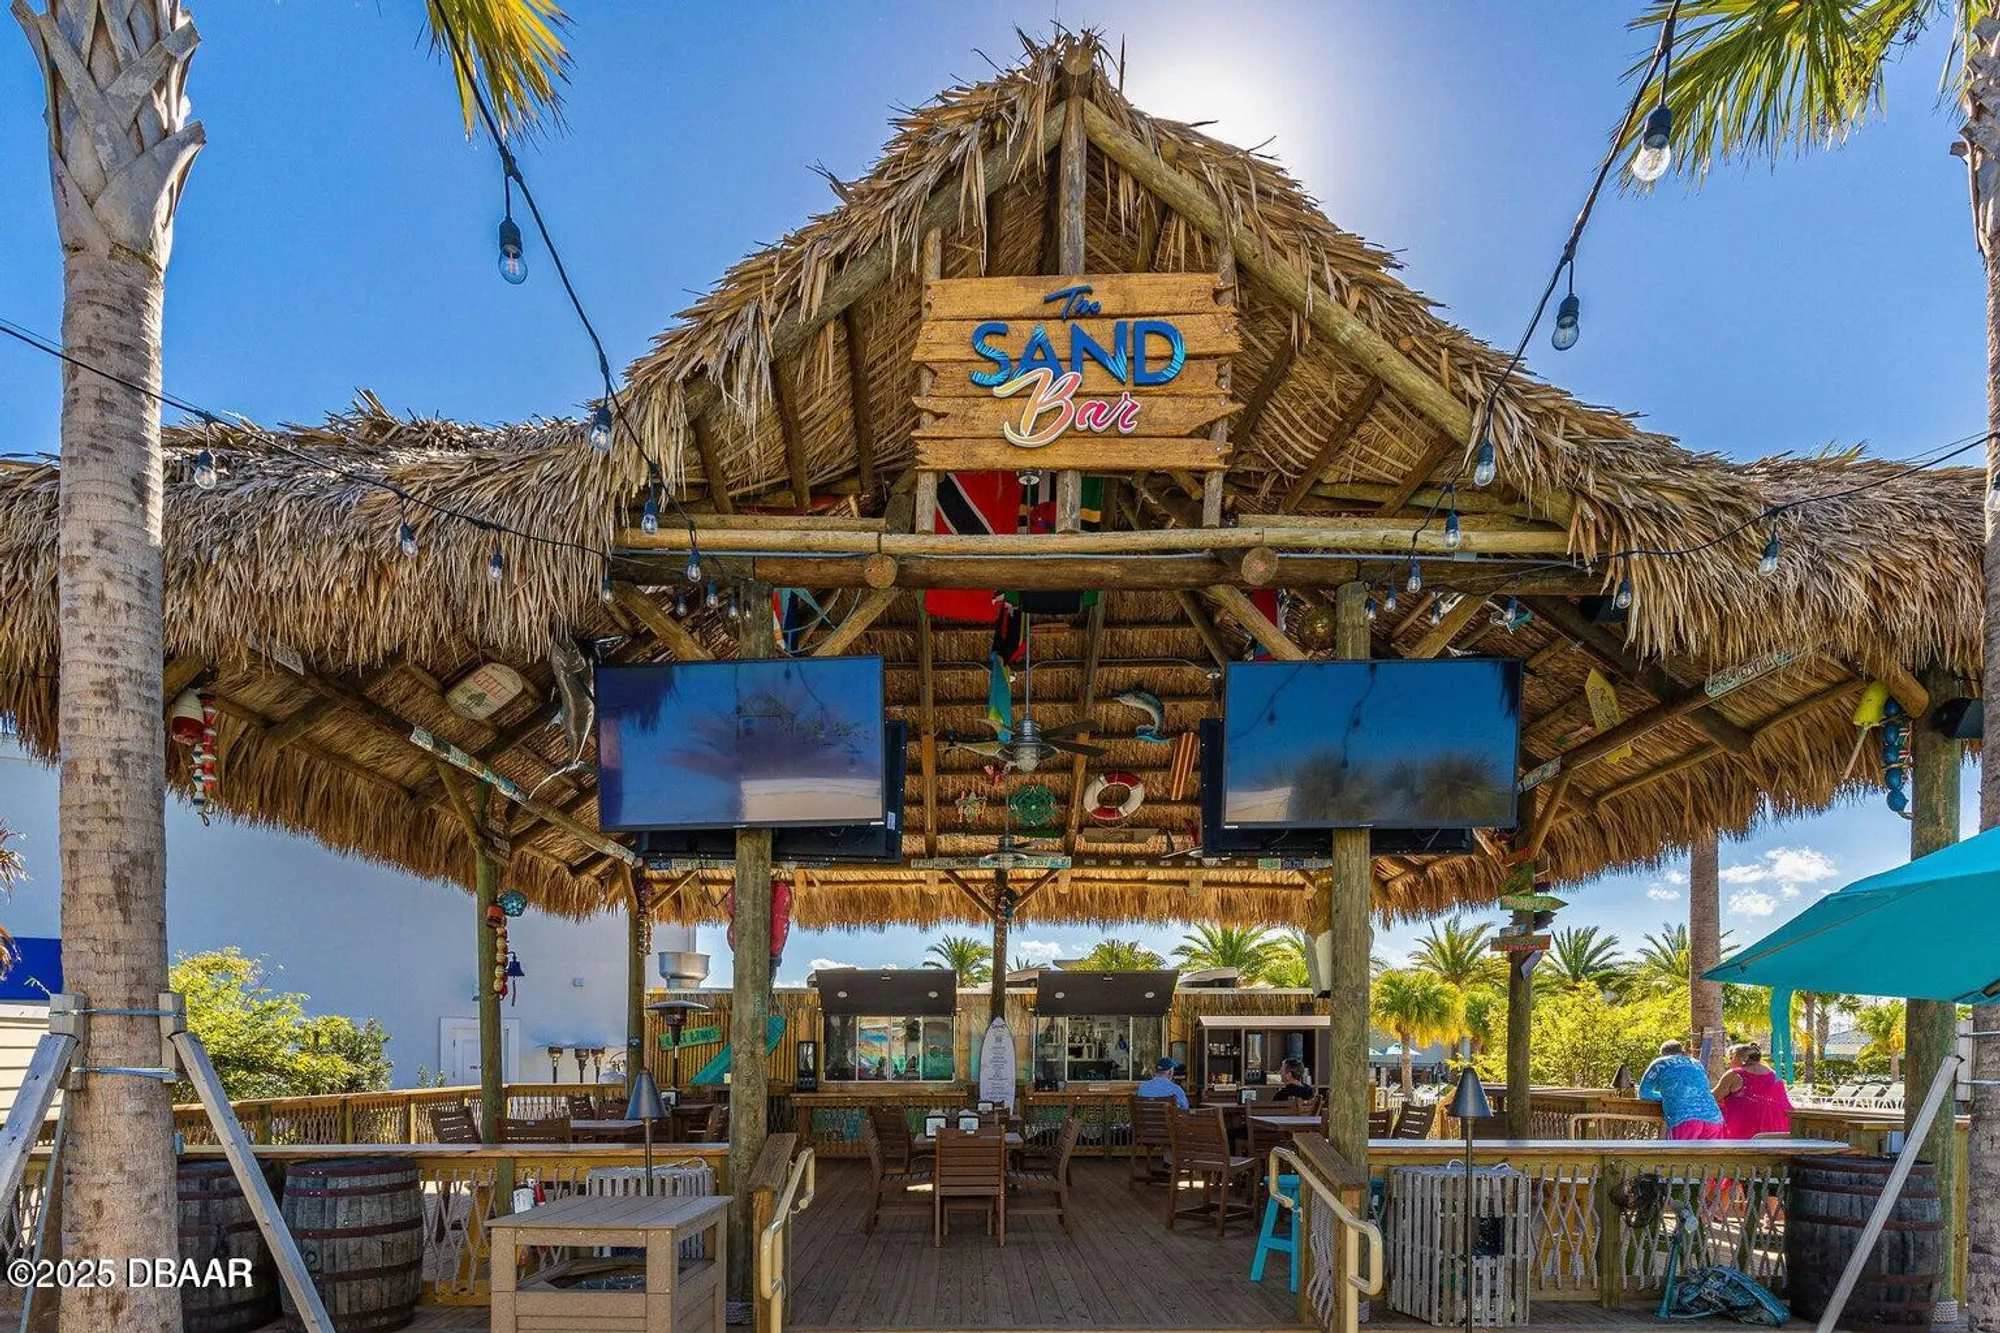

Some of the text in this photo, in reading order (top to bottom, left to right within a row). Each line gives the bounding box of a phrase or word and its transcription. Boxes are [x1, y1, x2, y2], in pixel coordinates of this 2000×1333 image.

[1043, 284, 1101, 322] The
[969, 320, 1185, 387] SAND
[992, 367, 1141, 447] Bar
